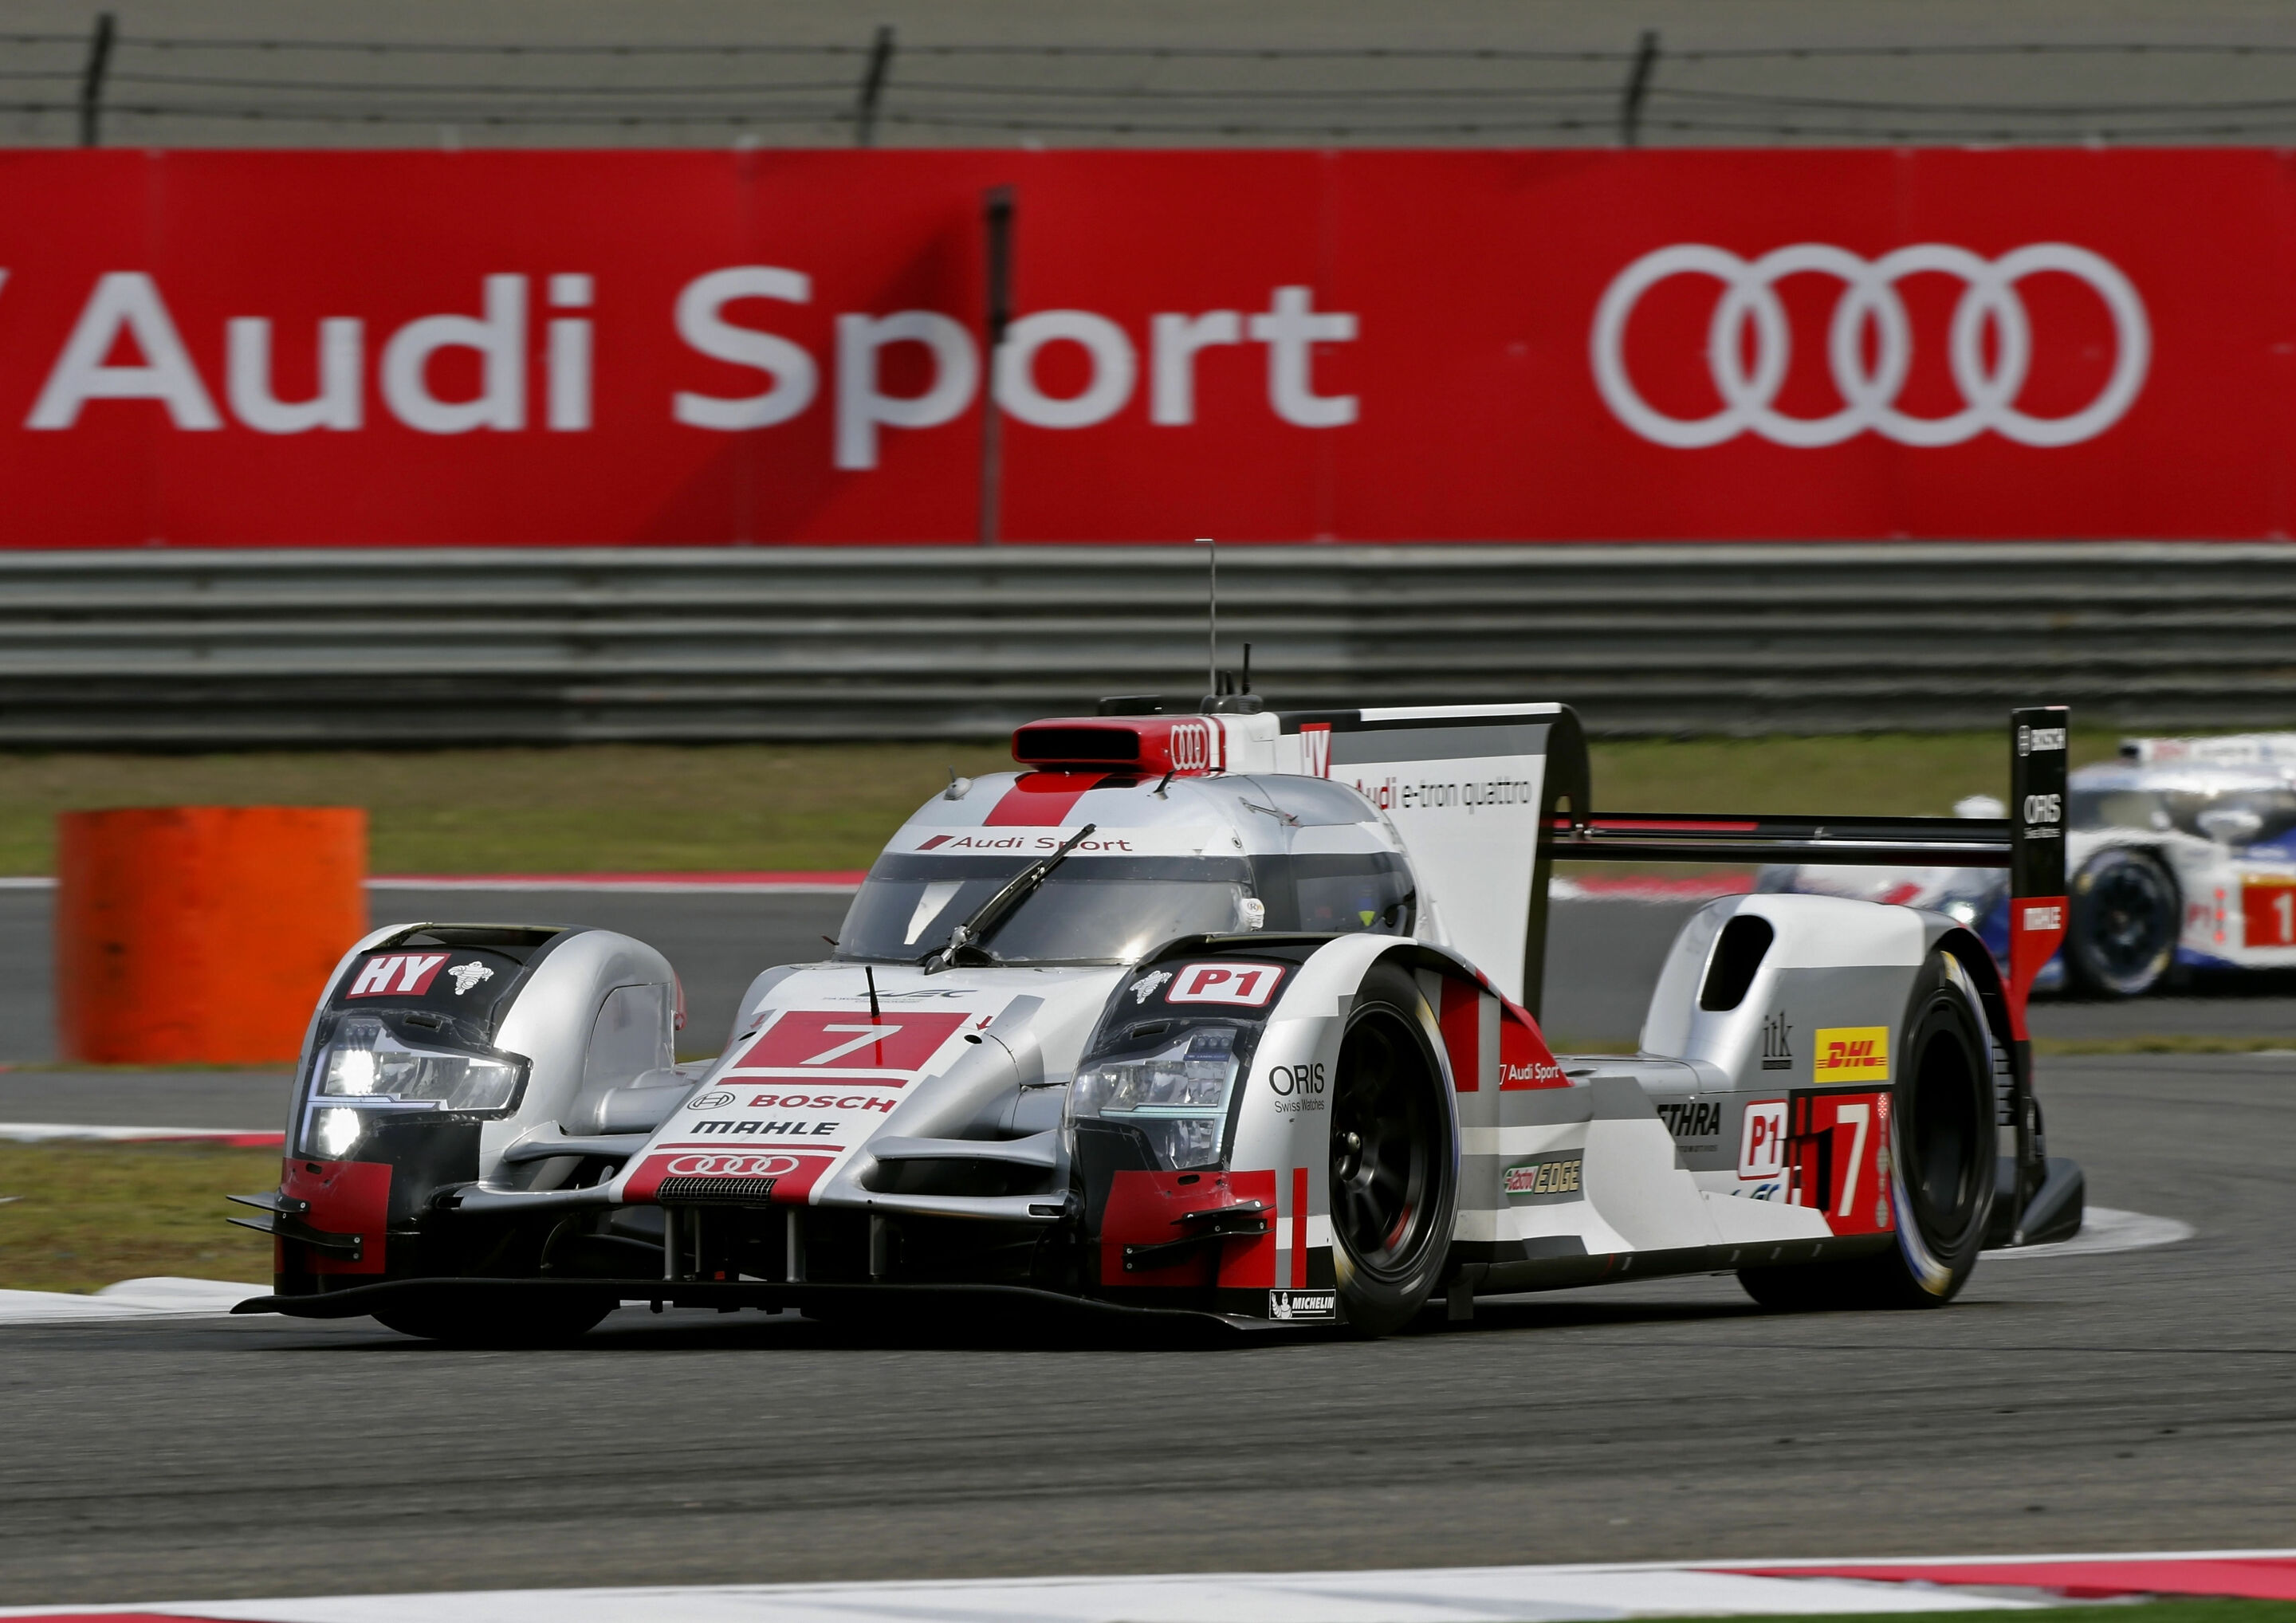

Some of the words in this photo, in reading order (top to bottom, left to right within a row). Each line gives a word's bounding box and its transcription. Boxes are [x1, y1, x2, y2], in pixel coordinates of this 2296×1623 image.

[22, 269, 594, 435] Audi
[672, 265, 1359, 470] Sport
[1401, 779, 1458, 808] e-tron
[1462, 773, 1532, 815] quattro
[950, 835, 1024, 848] Audi
[351, 956, 445, 995] HY
[1186, 969, 1263, 996] P1
[799, 1024, 903, 1065] 7
[1763, 1012, 1794, 1057] itk
[1827, 1040, 1876, 1069] DHL
[1268, 1063, 1325, 1096] ORIS
[1508, 1063, 1533, 1080] Audi
[1535, 1063, 1559, 1083] Sport
[747, 1094, 897, 1113] BOSCH
[1275, 1099, 1301, 1113] Swiss
[1301, 1098, 1325, 1111] Watches
[690, 1121, 839, 1136] MAHLE
[1748, 1114, 1779, 1166] P1
[1836, 1103, 1869, 1216] 7
[1534, 1159, 1582, 1194] EDGE
[1292, 1296, 1335, 1310] MICHELIN
